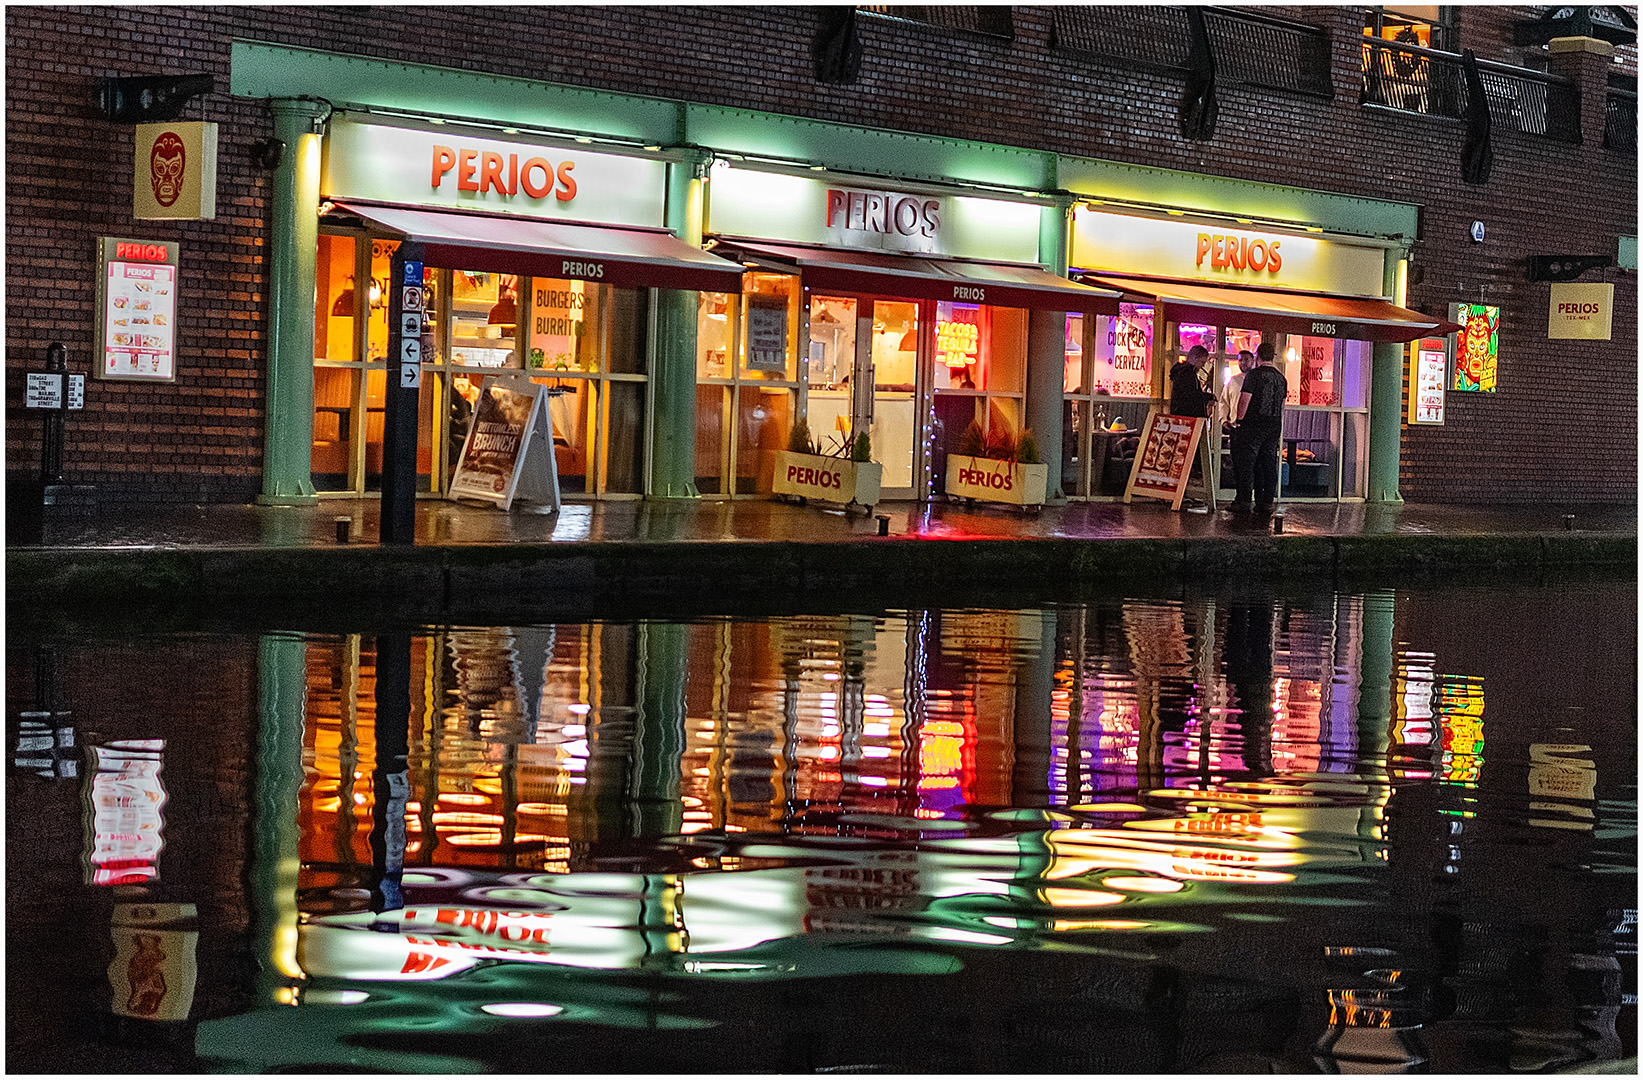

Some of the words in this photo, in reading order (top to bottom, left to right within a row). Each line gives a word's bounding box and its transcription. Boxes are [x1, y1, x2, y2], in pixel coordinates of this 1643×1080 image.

[431, 145, 577, 201] PERIOS
[826, 189, 941, 238] PERIOS
[116, 242, 168, 262] PERIOS
[1196, 232, 1282, 273] PERIOS
[126, 268, 152, 277] PERIOS
[562, 261, 604, 278] PERIOS
[536, 289, 585, 310] BURGERS
[953, 286, 985, 300] PERIOS
[1558, 303, 1599, 314] PERIOS
[536, 314, 575, 336] BURRIT
[938, 321, 970, 337] TACOS
[1312, 322, 1336, 335] PERIOS
[937, 335, 977, 354] TEQUILA
[1422, 339, 1443, 349] PERIOS
[945, 351, 967, 367] BAR
[1114, 354, 1145, 371] CERVEZA
[477, 421, 521, 435] BOTTOMLESS
[472, 432, 516, 453] BRUNCH
[787, 465, 841, 489] PERIOS
[959, 468, 1013, 490] PERIOS
